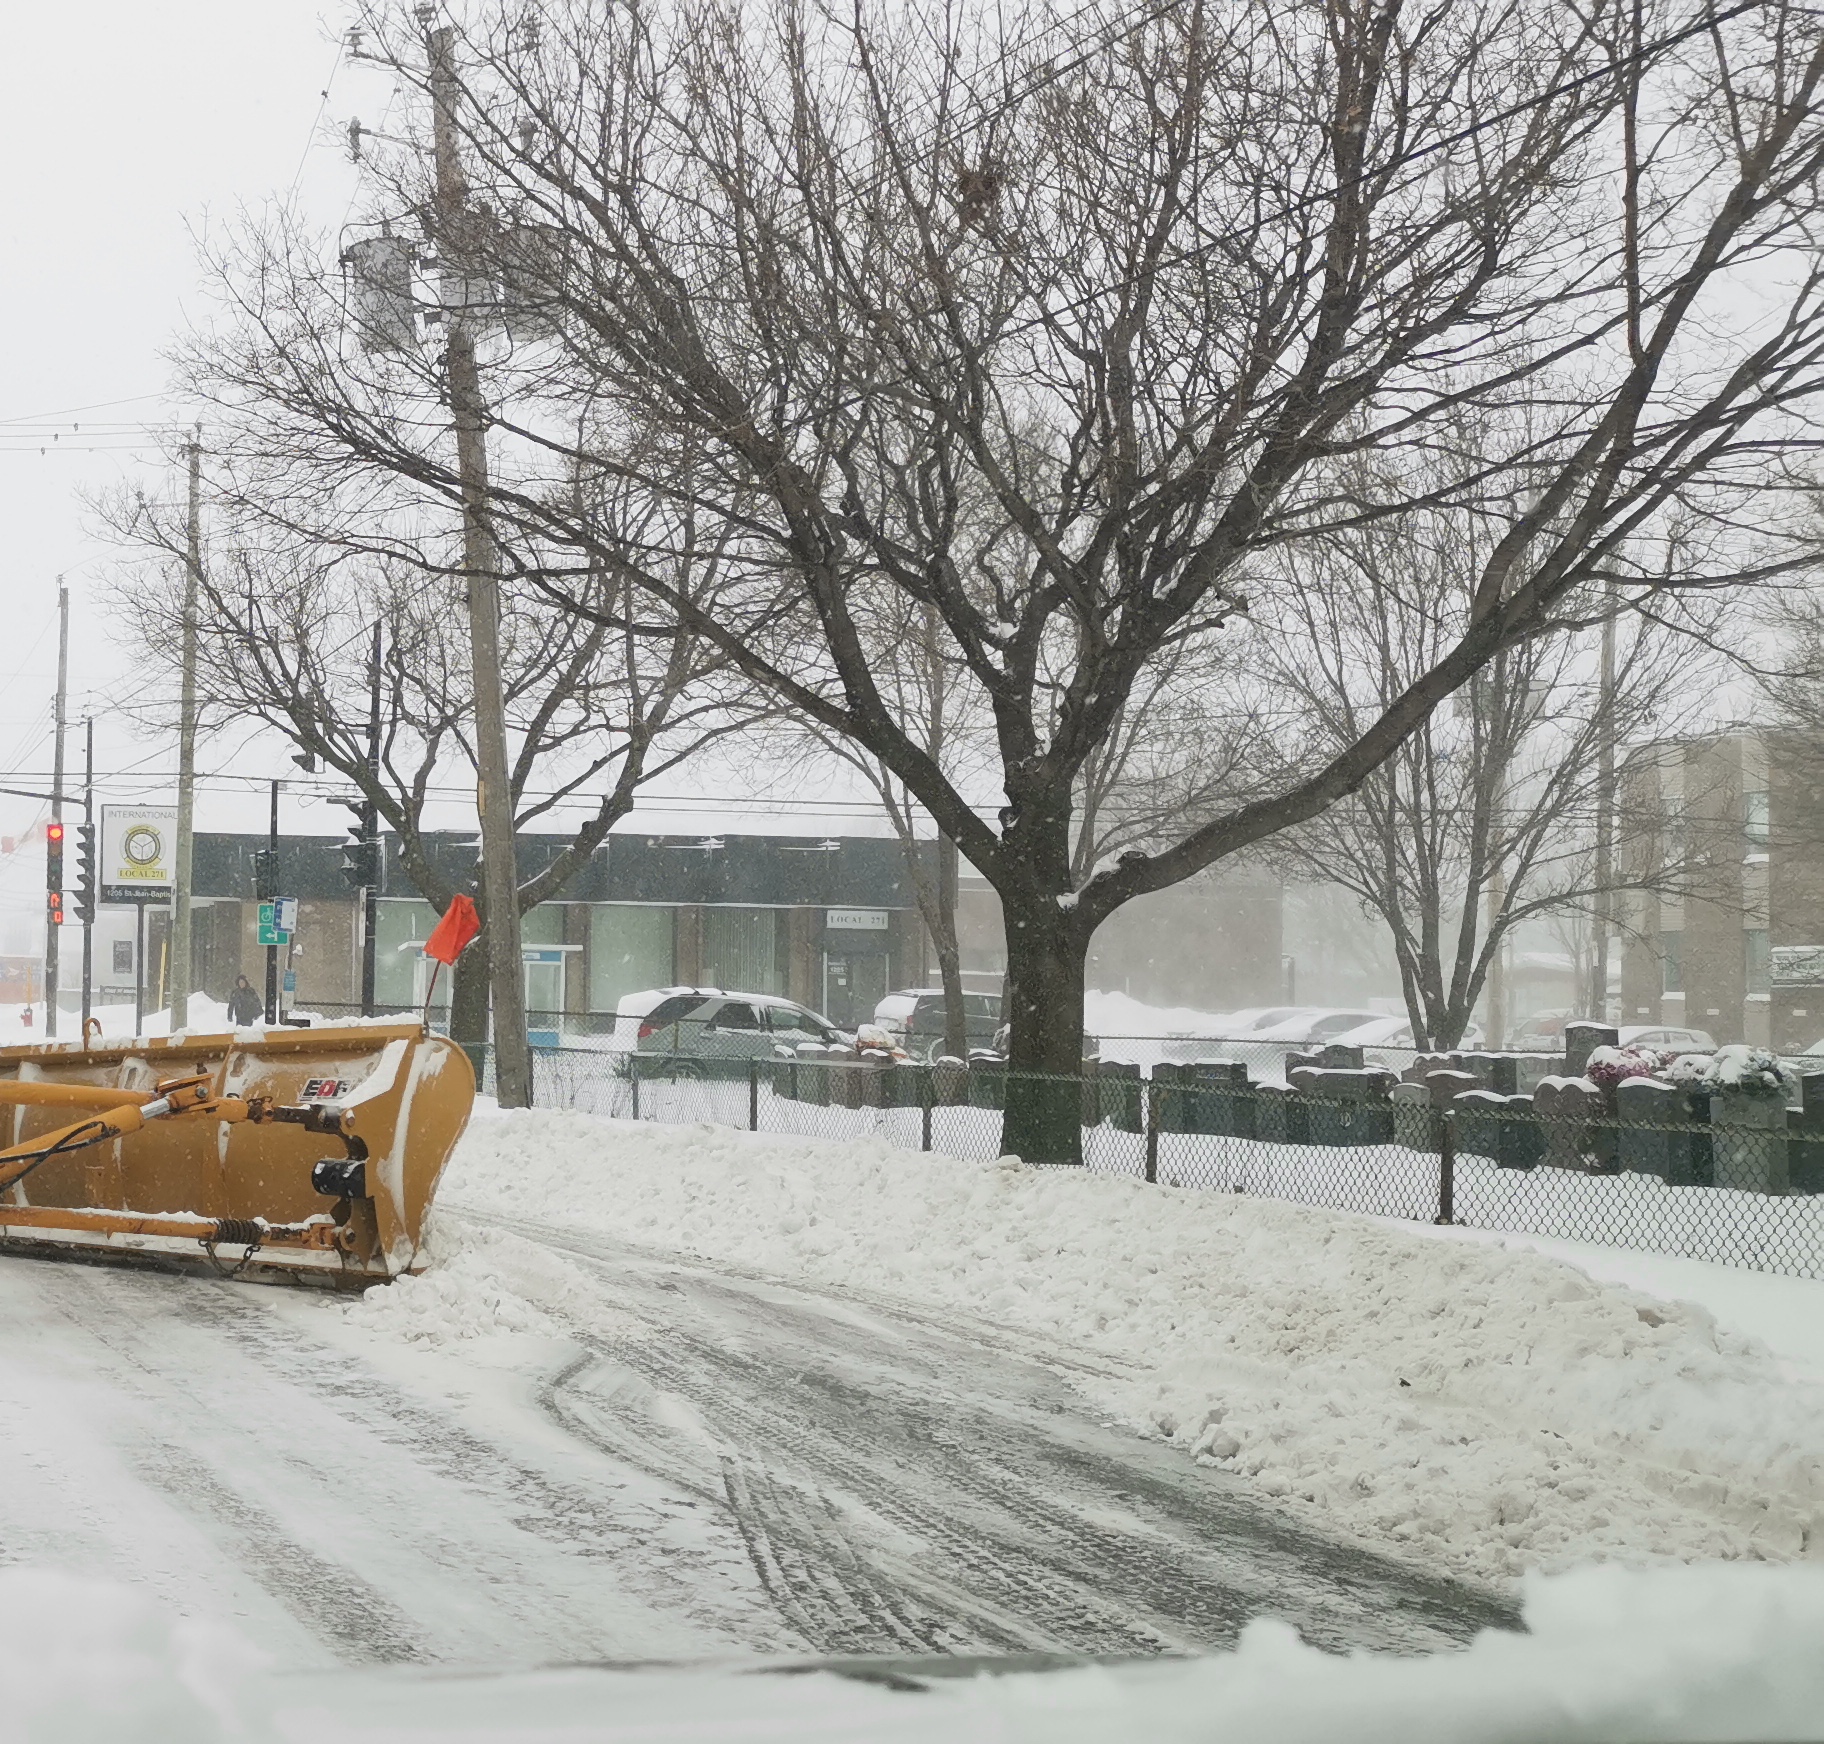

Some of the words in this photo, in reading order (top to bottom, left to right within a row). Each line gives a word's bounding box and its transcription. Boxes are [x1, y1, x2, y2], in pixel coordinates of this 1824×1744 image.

[107, 810, 179, 820] INTERNATIONAL
[119, 869, 150, 878] LOCAL
[151, 869, 164, 878] 271
[830, 915, 862, 924] LOCAL
